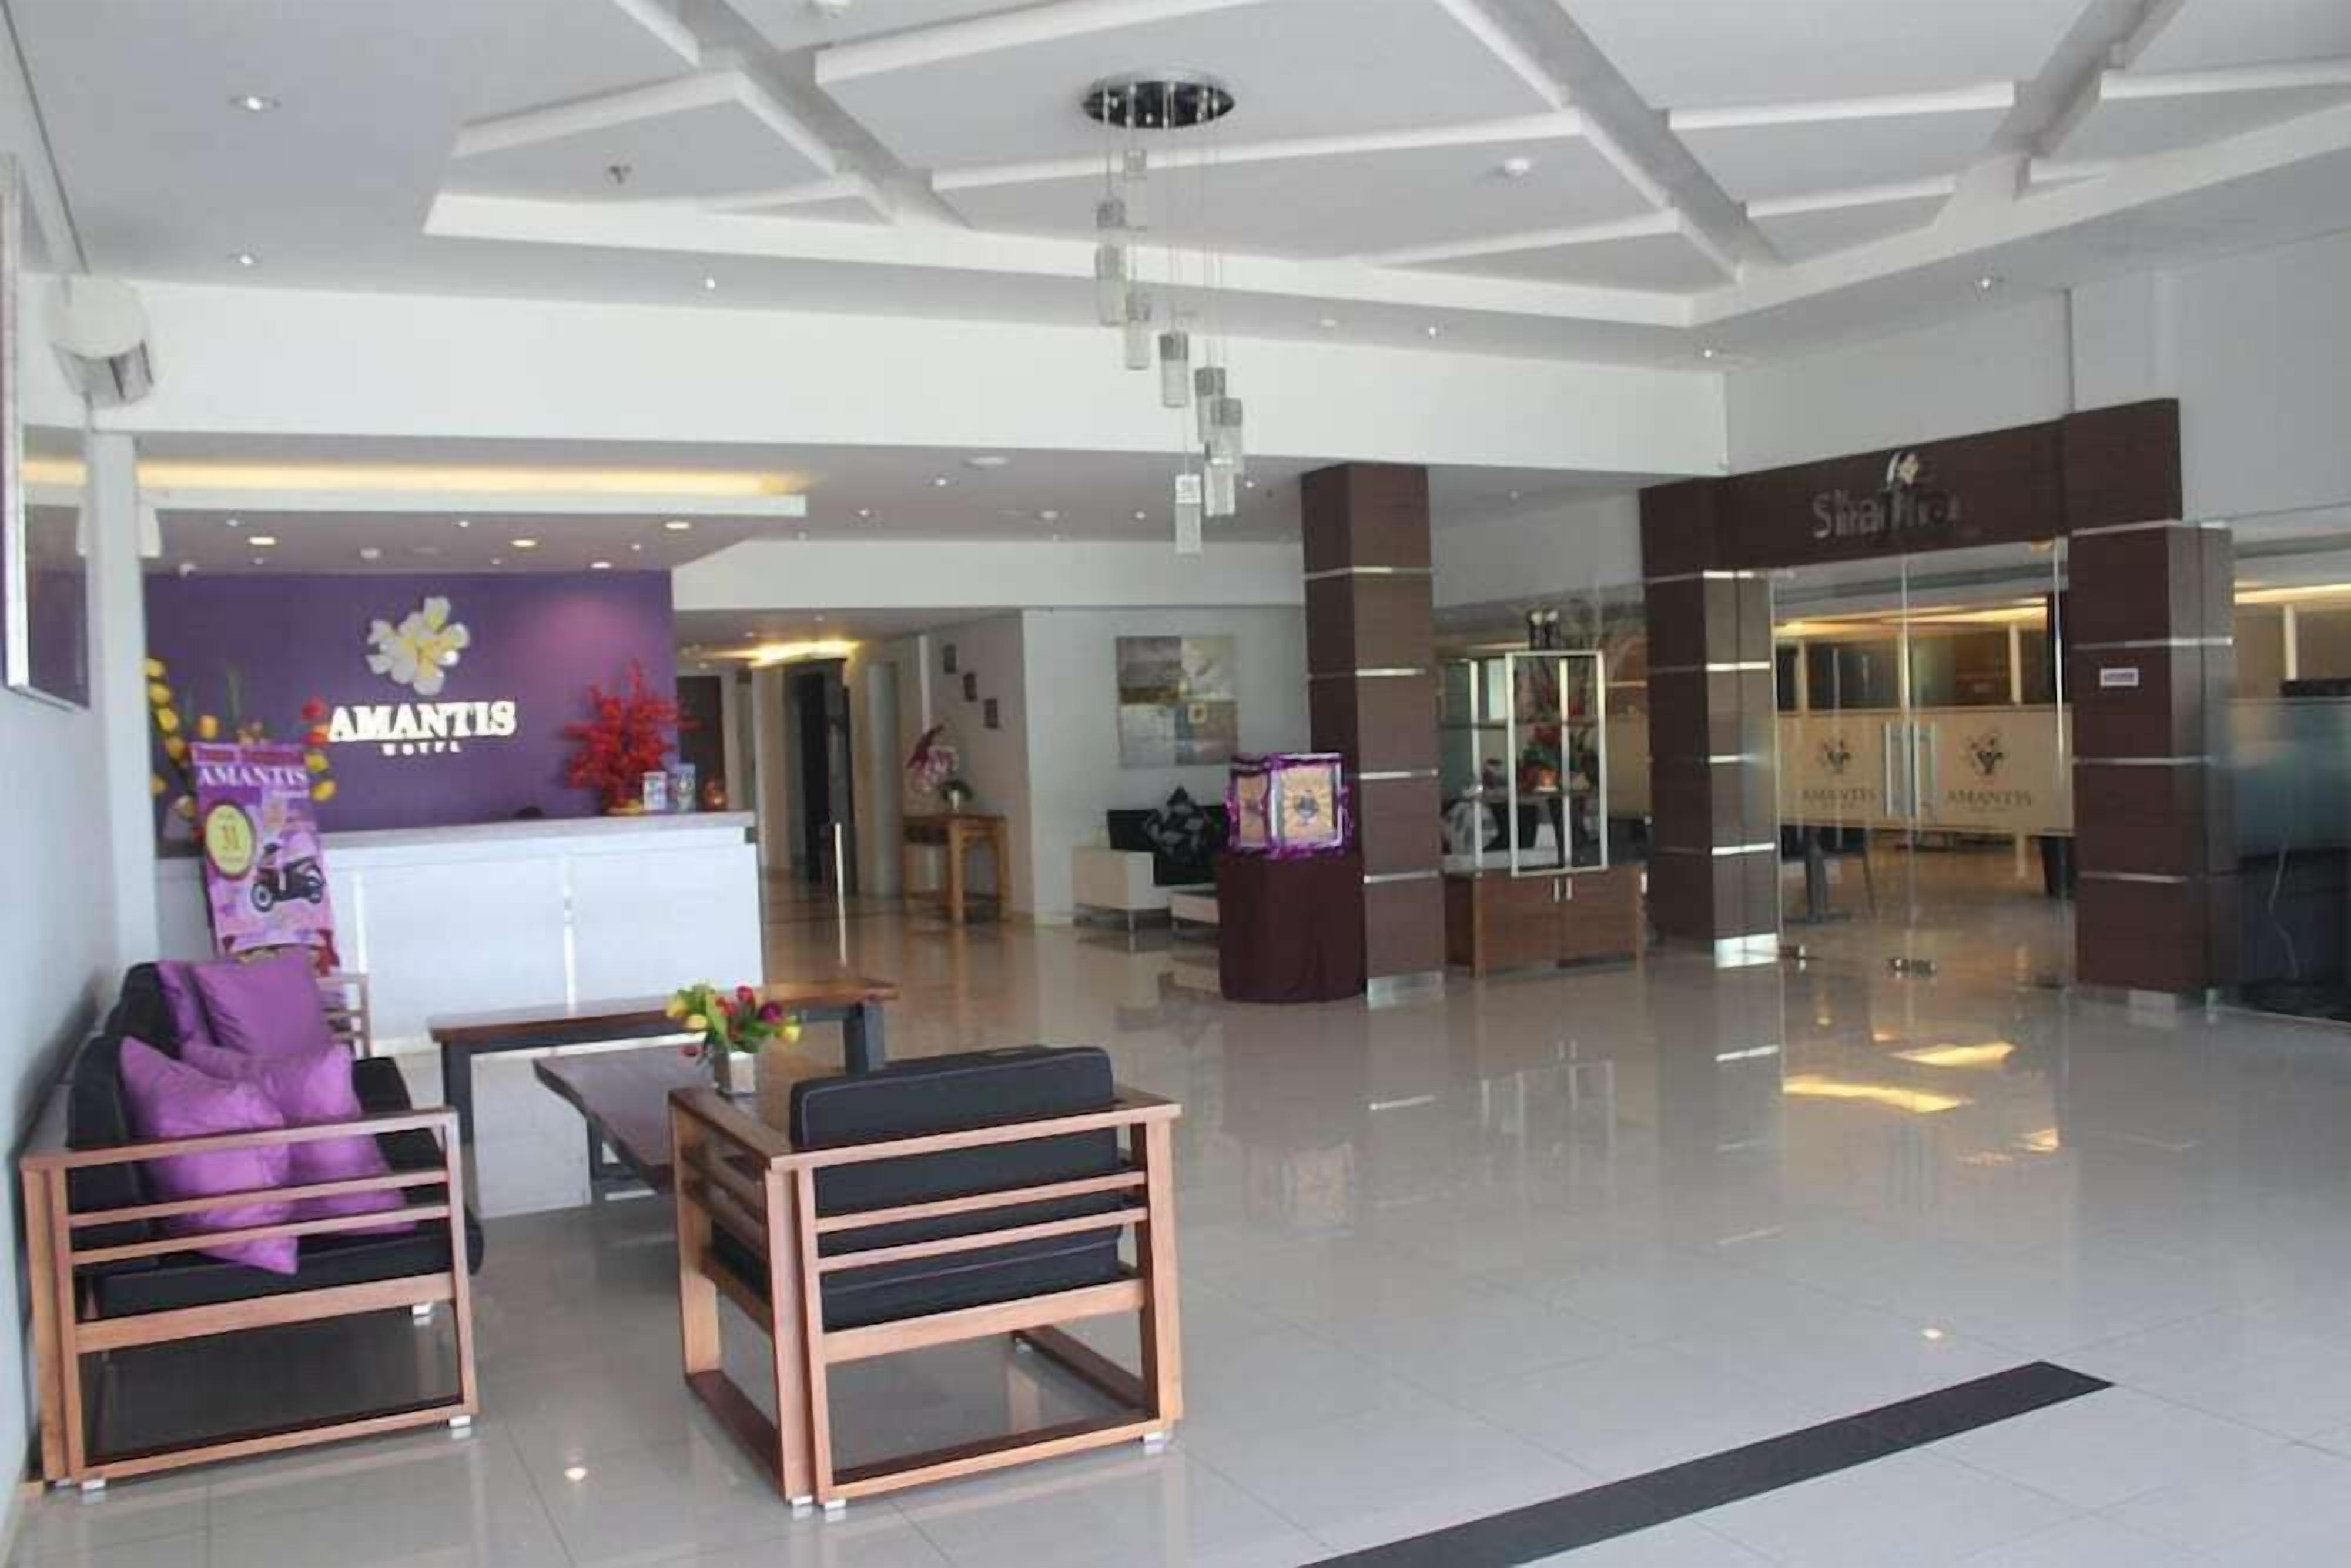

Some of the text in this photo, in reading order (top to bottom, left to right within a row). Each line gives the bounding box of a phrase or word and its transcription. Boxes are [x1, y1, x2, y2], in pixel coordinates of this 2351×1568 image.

[327, 700, 517, 742] AMANTIS
[196, 766, 309, 786] AMANTIS
[1947, 789, 2032, 806] AMANTIS
